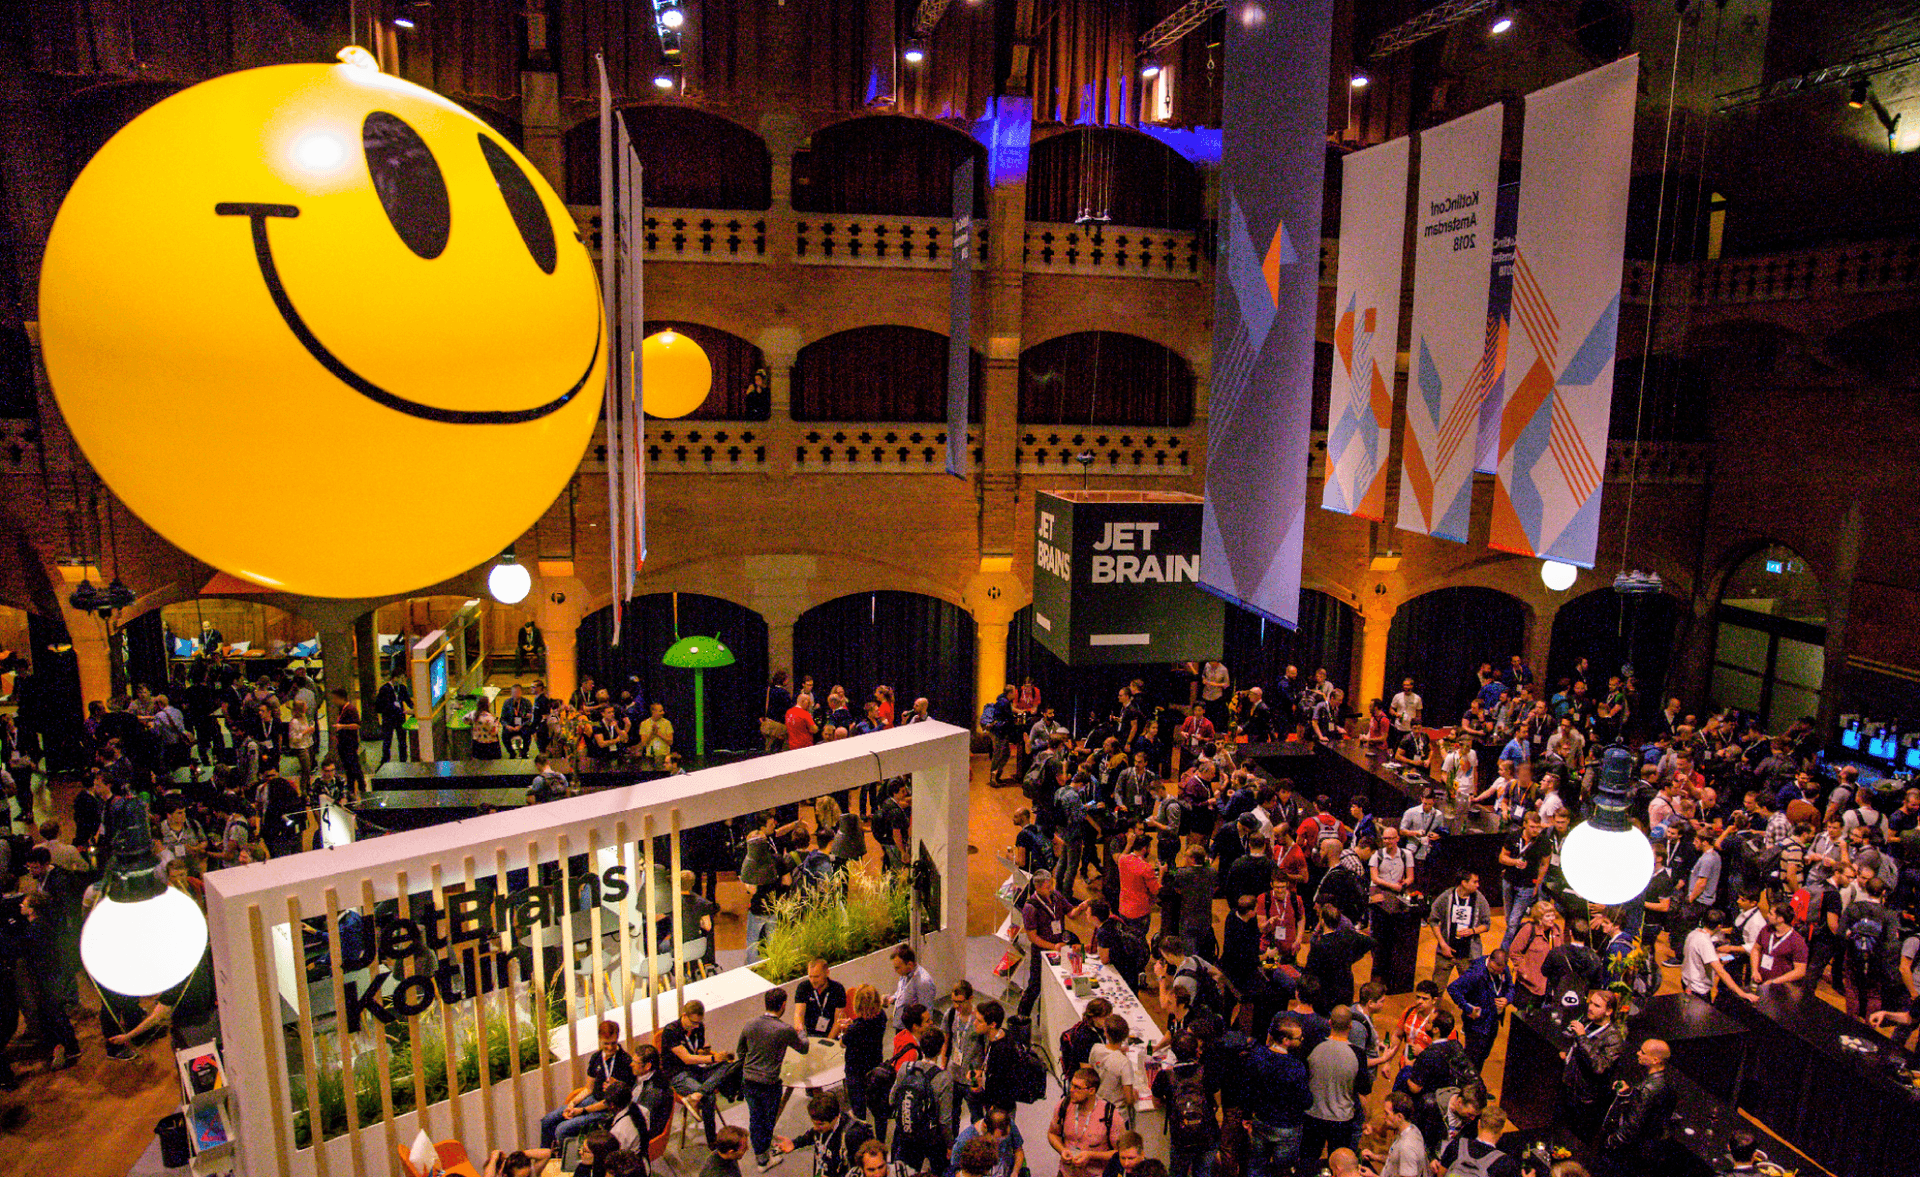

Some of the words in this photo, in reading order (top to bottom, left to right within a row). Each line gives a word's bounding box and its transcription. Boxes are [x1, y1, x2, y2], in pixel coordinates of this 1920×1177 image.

[1038, 511, 1055, 541] JET
[1092, 522, 1160, 550] JET
[1037, 540, 1071, 582] BRAINS
[1091, 554, 1200, 583] BRAIN
[341, 865, 629, 974] JetBrains
[343, 942, 533, 1034] Kotlin
